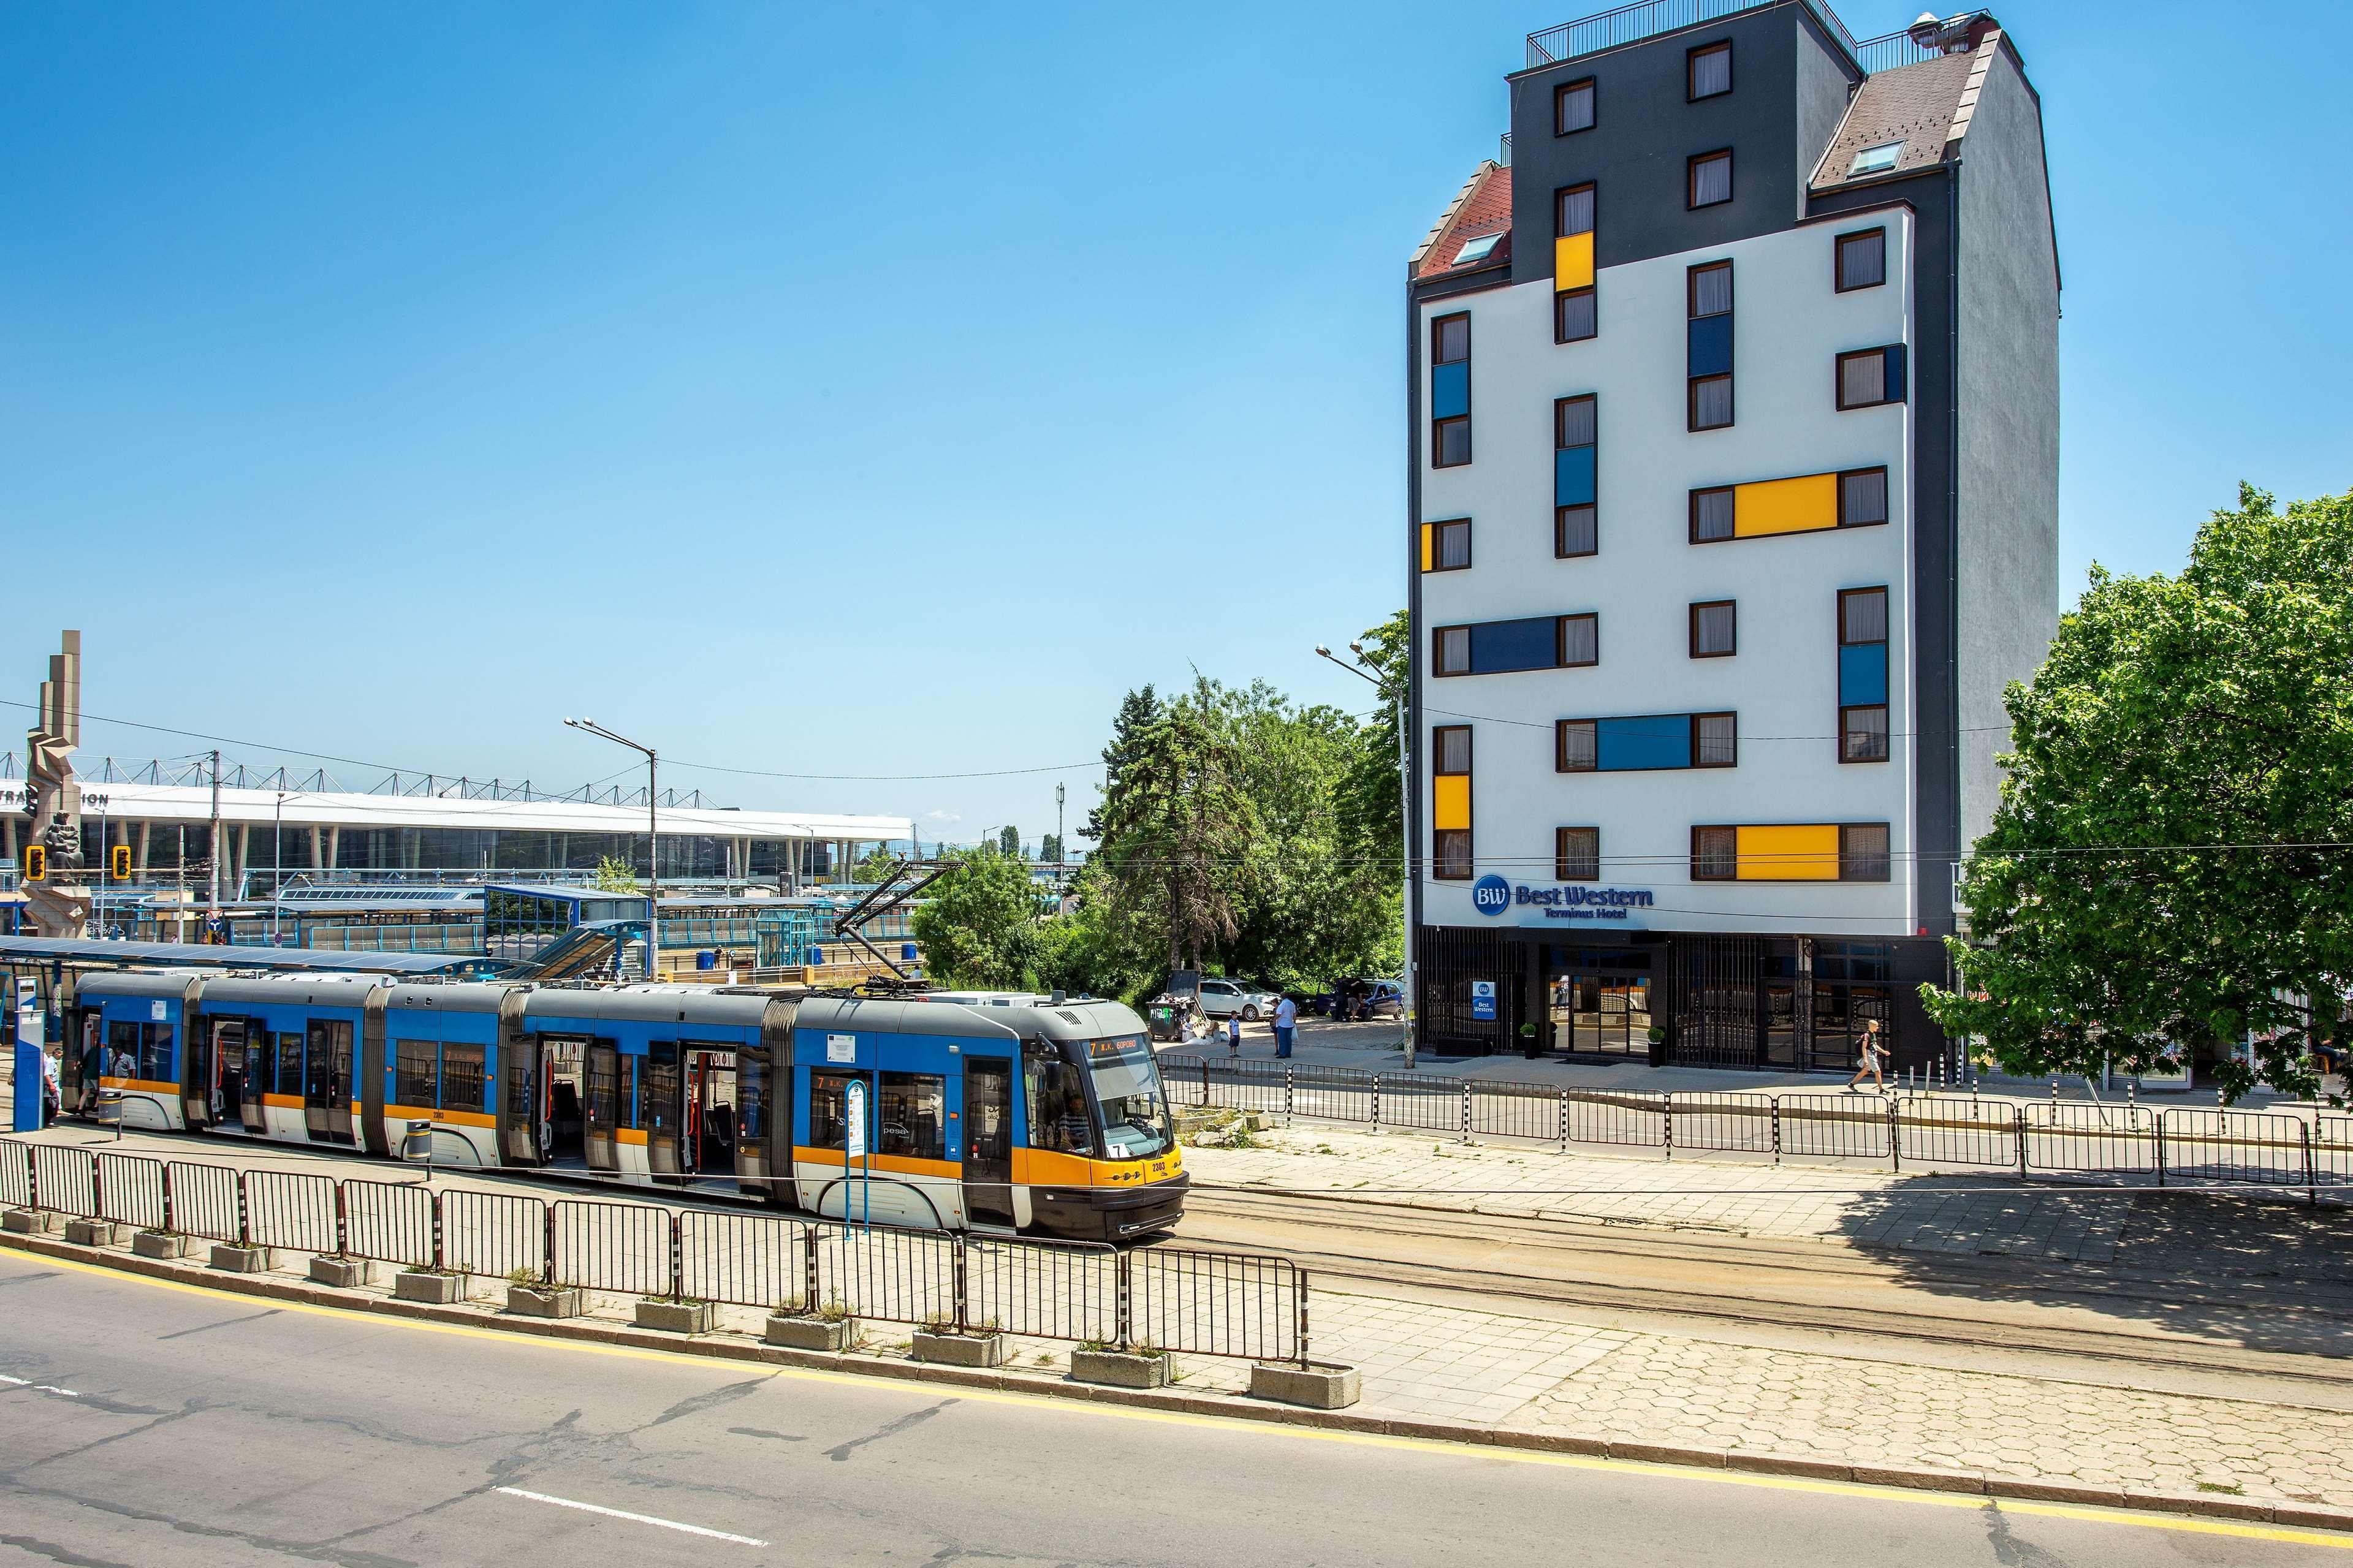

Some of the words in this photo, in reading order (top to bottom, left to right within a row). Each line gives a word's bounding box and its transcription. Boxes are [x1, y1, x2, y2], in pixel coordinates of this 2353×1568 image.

[82, 793, 108, 804] ION
[1478, 888, 1506, 904] BW
[1516, 886, 1562, 905] Best
[1564, 886, 1654, 906] Western
[1543, 907, 1594, 918] Terminus
[1596, 908, 1627, 918] Hotel
[1090, 1043, 1096, 1055] 7
[818, 1077, 824, 1088] 7
[1113, 1145, 1120, 1157] 7
[1152, 1161, 1165, 1172] 2303
